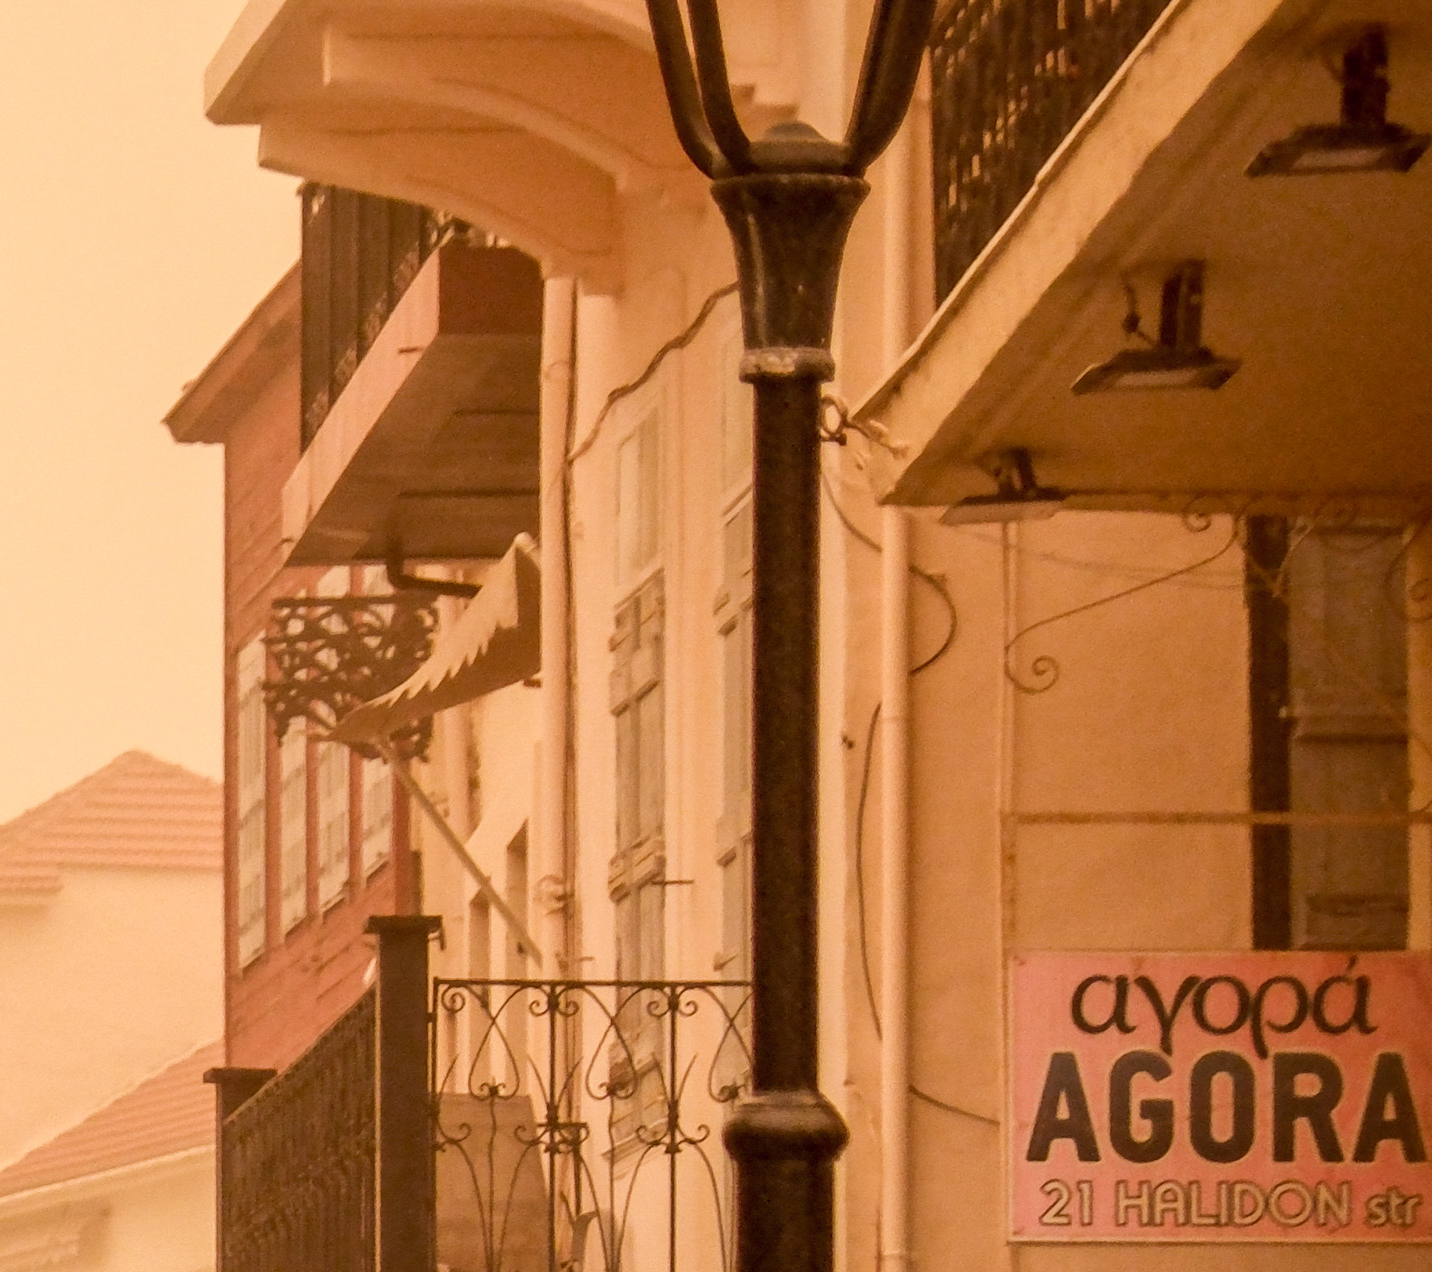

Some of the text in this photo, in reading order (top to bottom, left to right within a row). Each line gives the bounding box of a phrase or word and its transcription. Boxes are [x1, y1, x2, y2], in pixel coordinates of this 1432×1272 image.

[1070, 954, 1380, 1060] αγορά
[1025, 1049, 1429, 1164] AGORA
[1039, 1177, 1423, 1229] 21 HALIDON str
